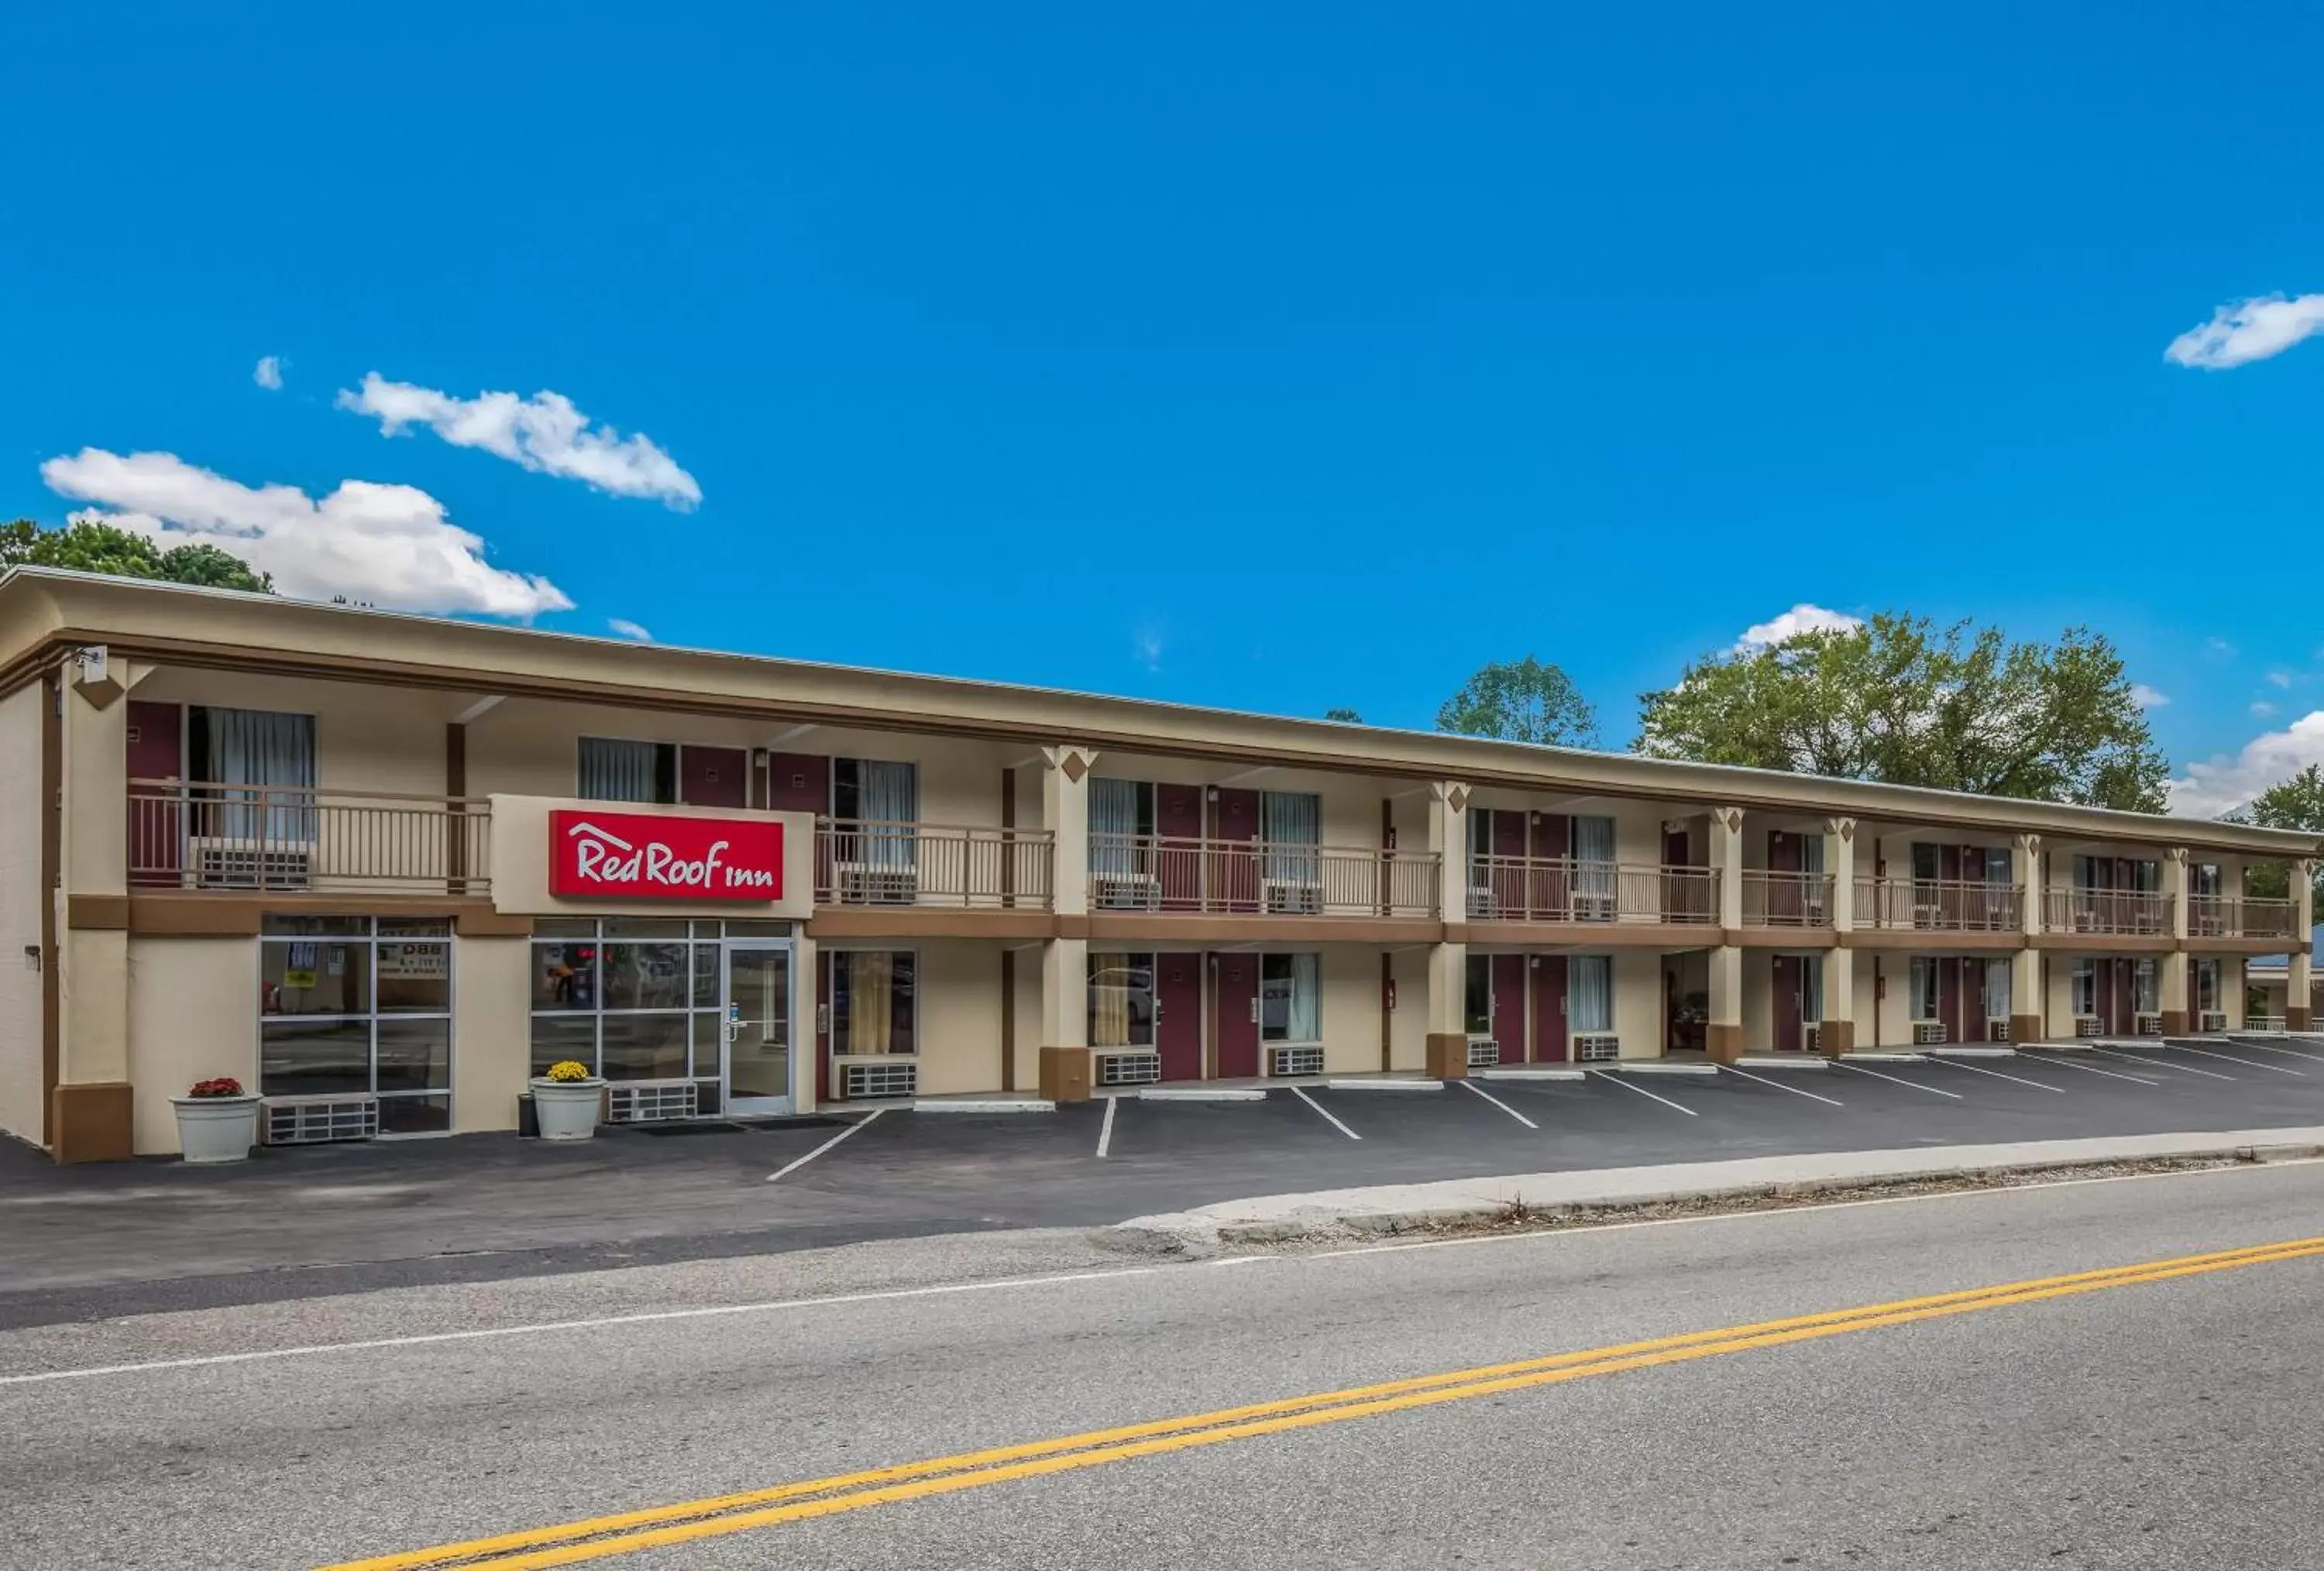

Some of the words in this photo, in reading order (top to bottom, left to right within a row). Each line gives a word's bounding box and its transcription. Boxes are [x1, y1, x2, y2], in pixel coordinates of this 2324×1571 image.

[577, 839, 643, 882] Red
[647, 841, 729, 889] Roof
[724, 867, 773, 887] Inn
